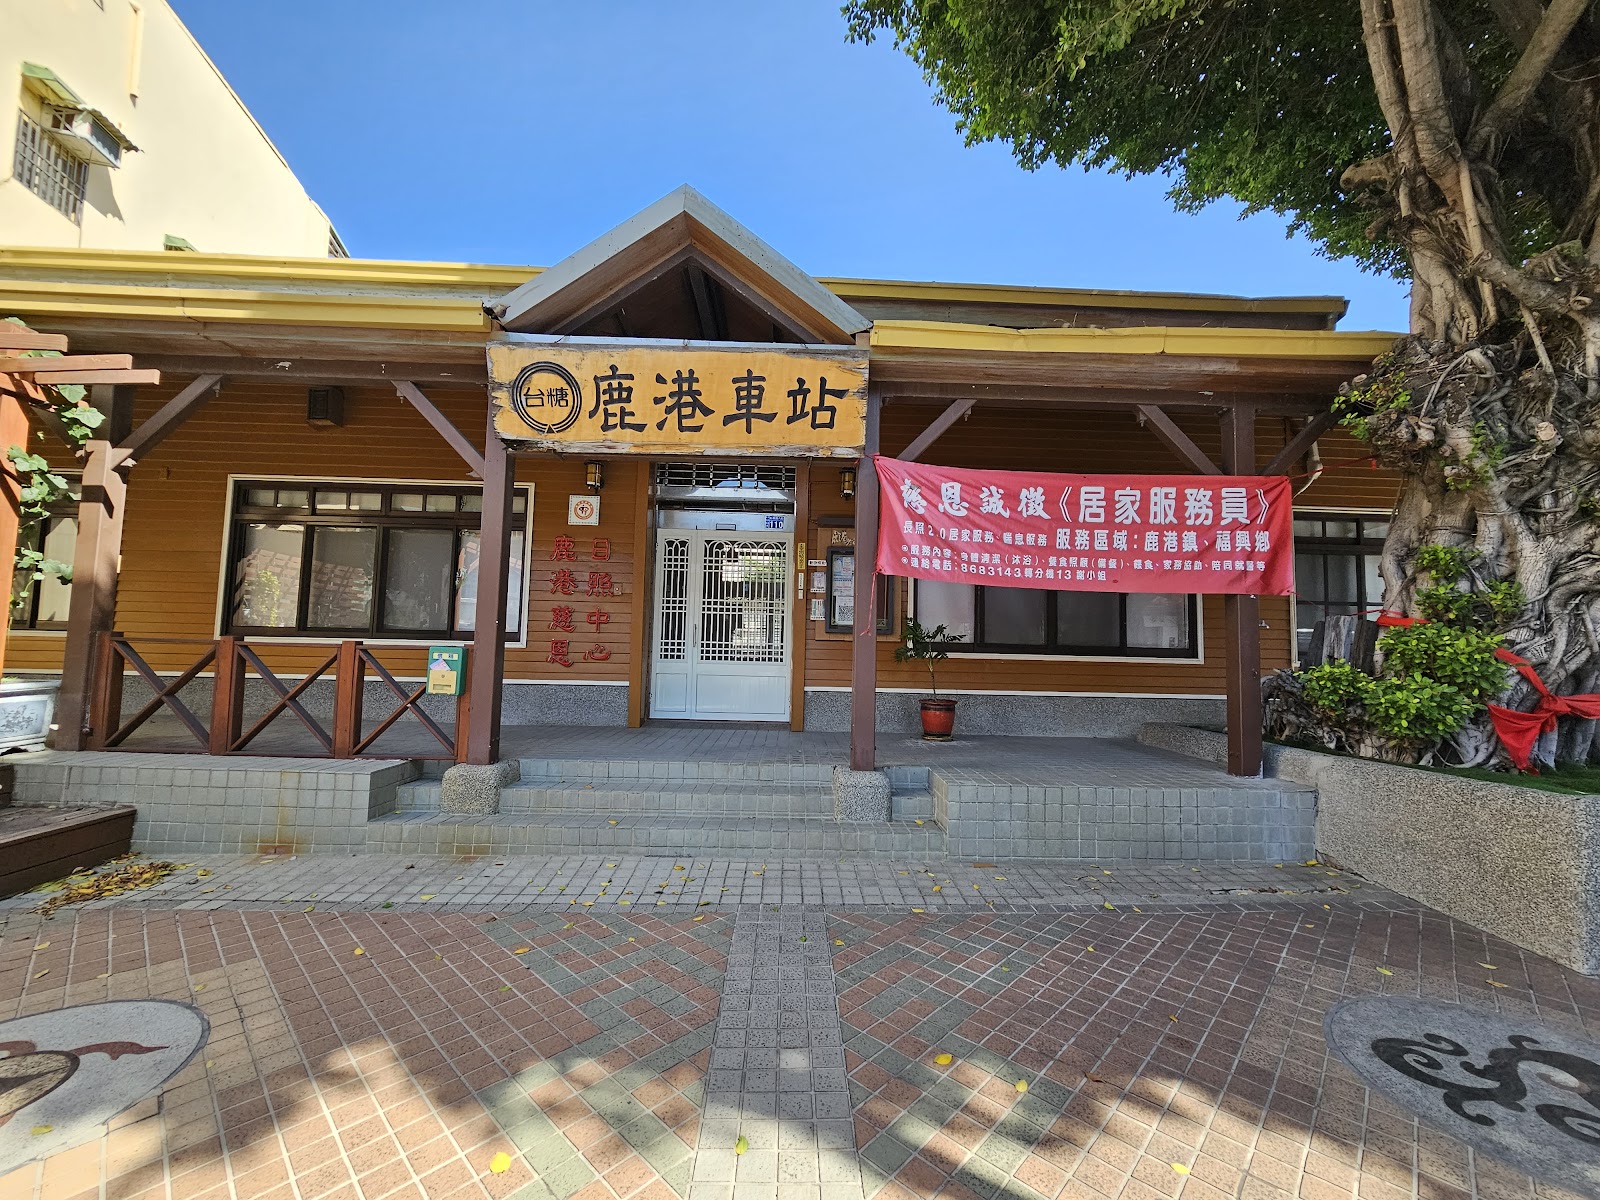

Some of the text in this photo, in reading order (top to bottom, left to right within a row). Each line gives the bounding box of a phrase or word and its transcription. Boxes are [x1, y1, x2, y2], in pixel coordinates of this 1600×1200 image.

[523, 386, 569, 408] 台糖
[588, 364, 849, 434] 鹿港車站
[546, 534, 578, 668] 鹿港慈恩
[583, 537, 615, 662] 日照中心
[1076, 569, 1107, 581] 謝小姐
